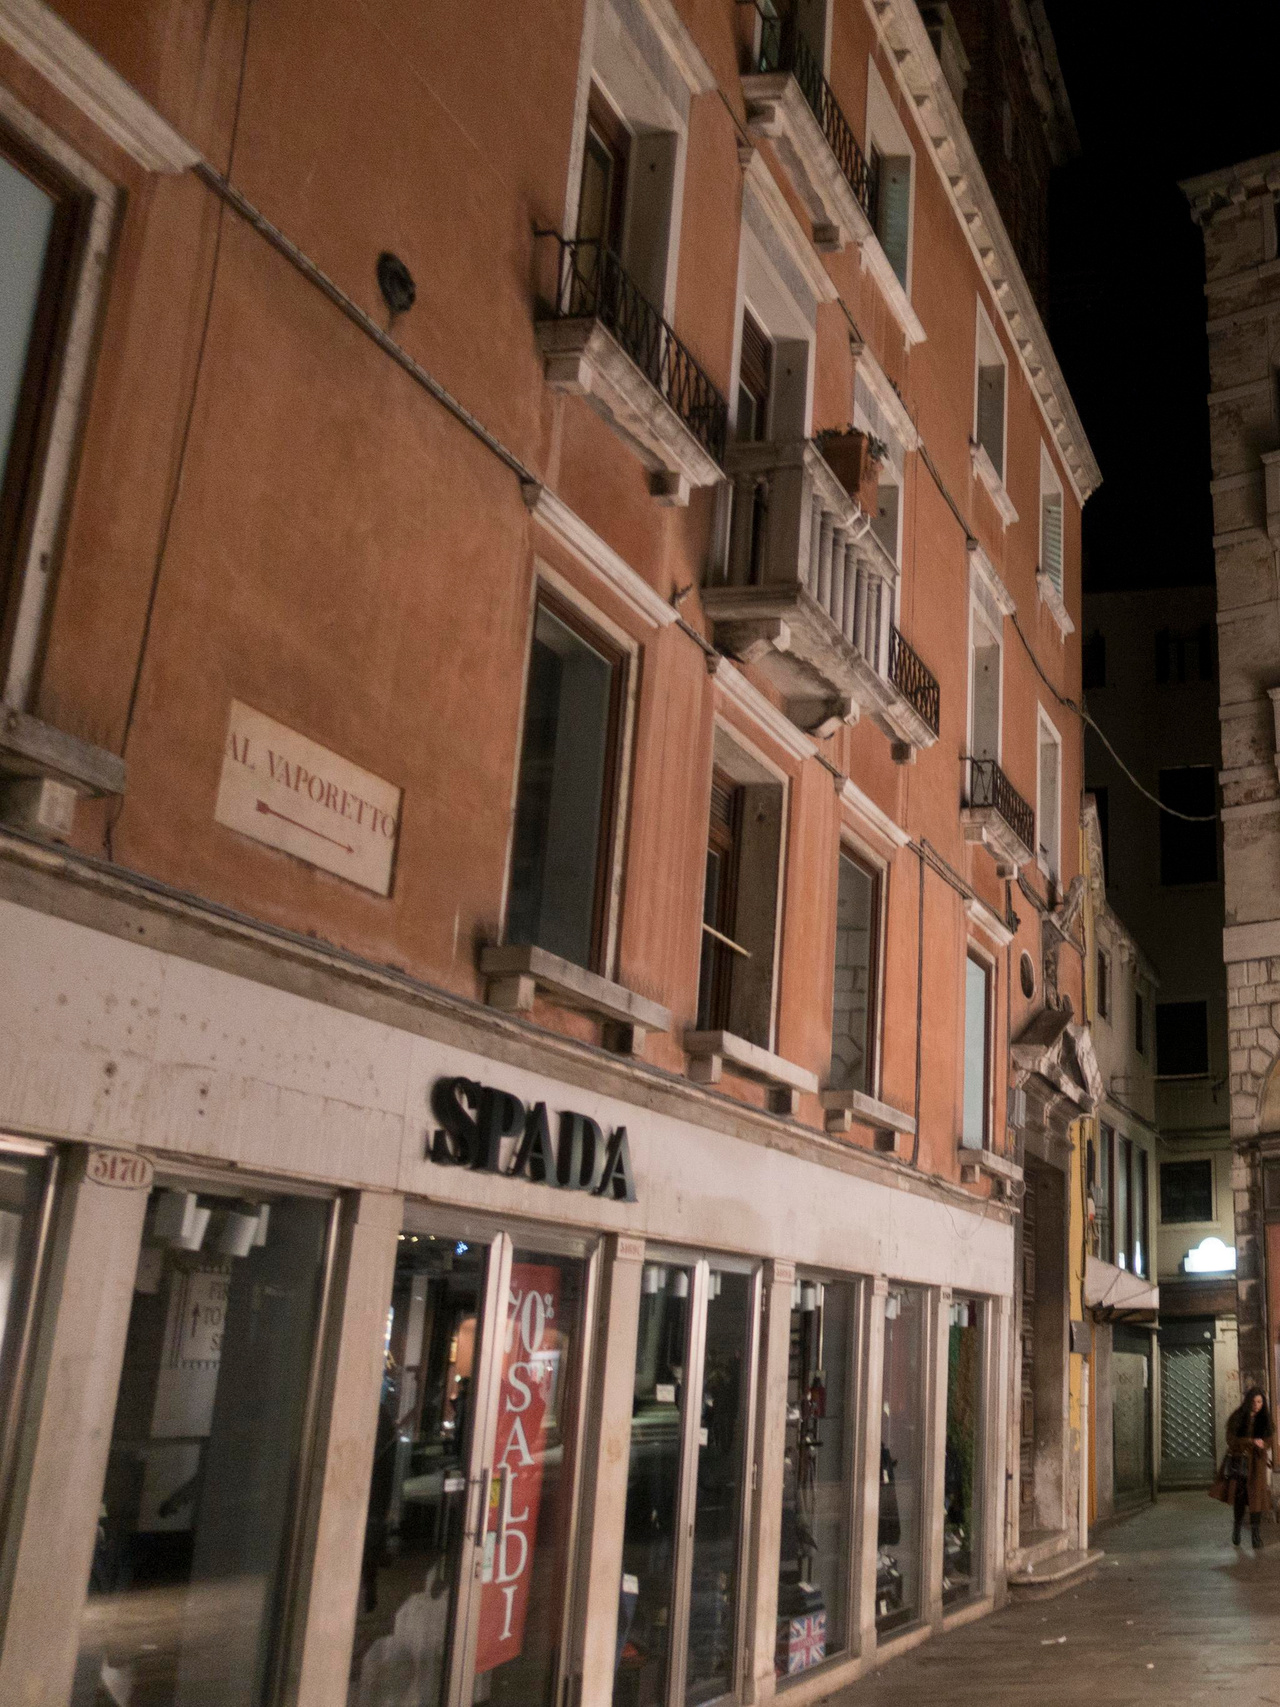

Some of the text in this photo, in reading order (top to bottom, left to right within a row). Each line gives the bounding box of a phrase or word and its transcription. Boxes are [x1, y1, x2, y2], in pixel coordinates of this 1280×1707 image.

[227, 732, 396, 840] AL VAPORETTO
[94, 1153, 147, 1183] 5170
[424, 1076, 639, 1203] SPADA
[495, 1360, 536, 1642] SALDI
